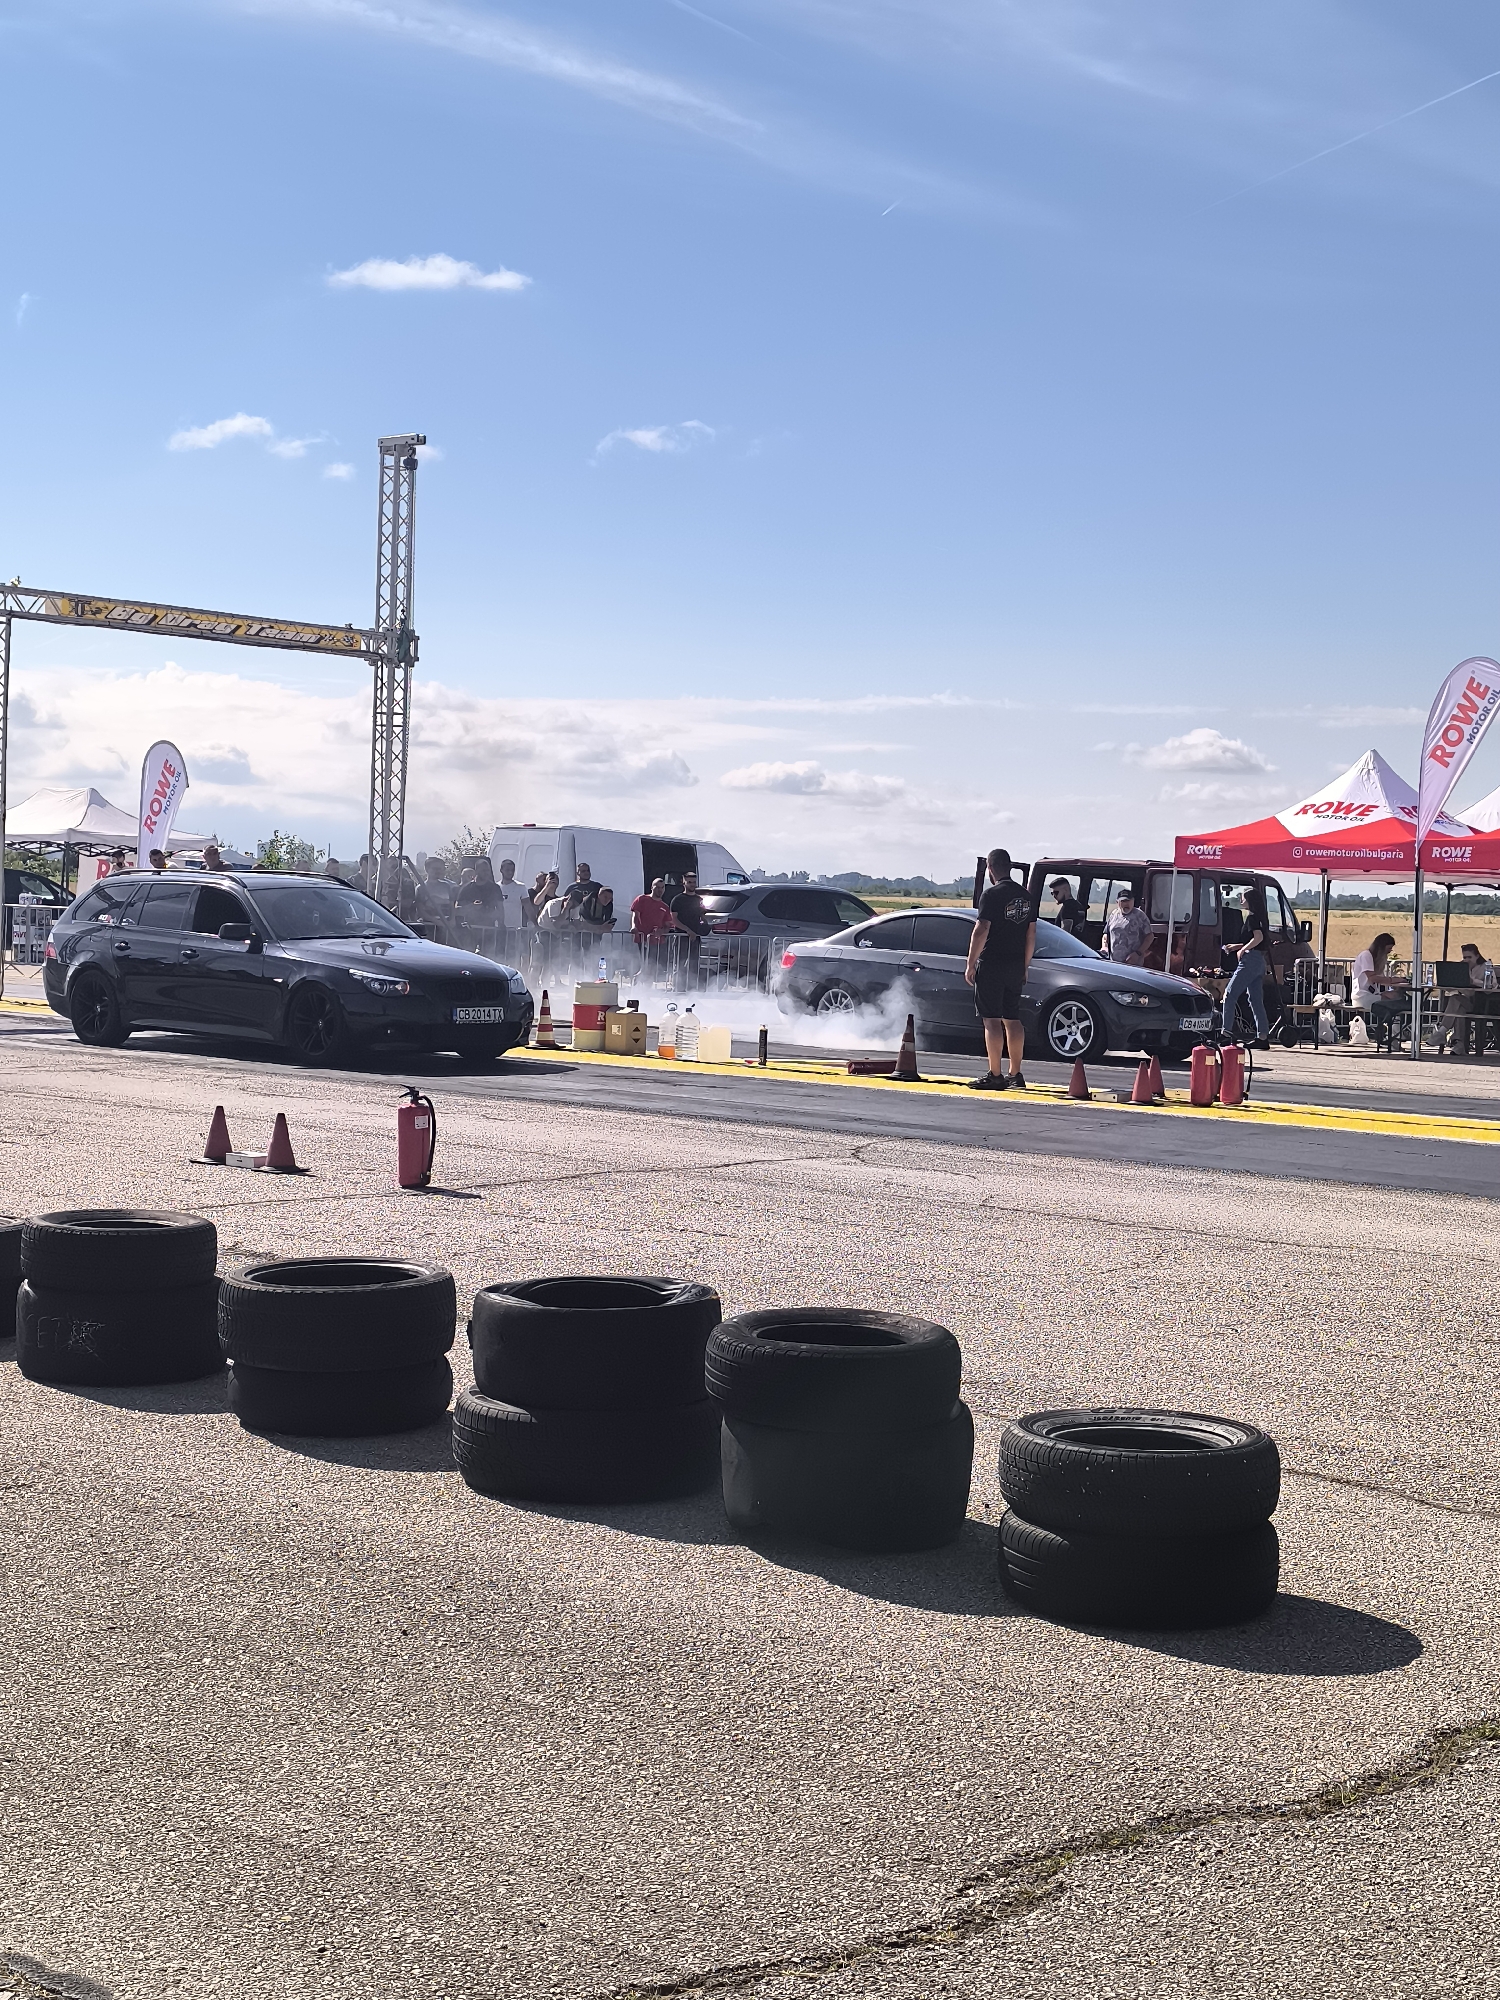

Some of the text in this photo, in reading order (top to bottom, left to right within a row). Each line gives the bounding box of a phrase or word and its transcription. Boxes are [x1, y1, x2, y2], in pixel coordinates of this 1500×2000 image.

[157, 611, 239, 634] Drag
[246, 622, 323, 643] Team
[1429, 676, 1490, 768] ROWE
[1466, 705, 1491, 744] MOTOR
[143, 758, 176, 835] ROWE
[162, 783, 177, 815] MOTOR
[1294, 801, 1380, 816] ROWE
[1187, 845, 1222, 855] ROWE
[1305, 847, 1404, 860] rowemotoroilbulgaria
[1432, 846, 1473, 858] ROWE
[459, 1009, 502, 1020] CB 2014 TX
